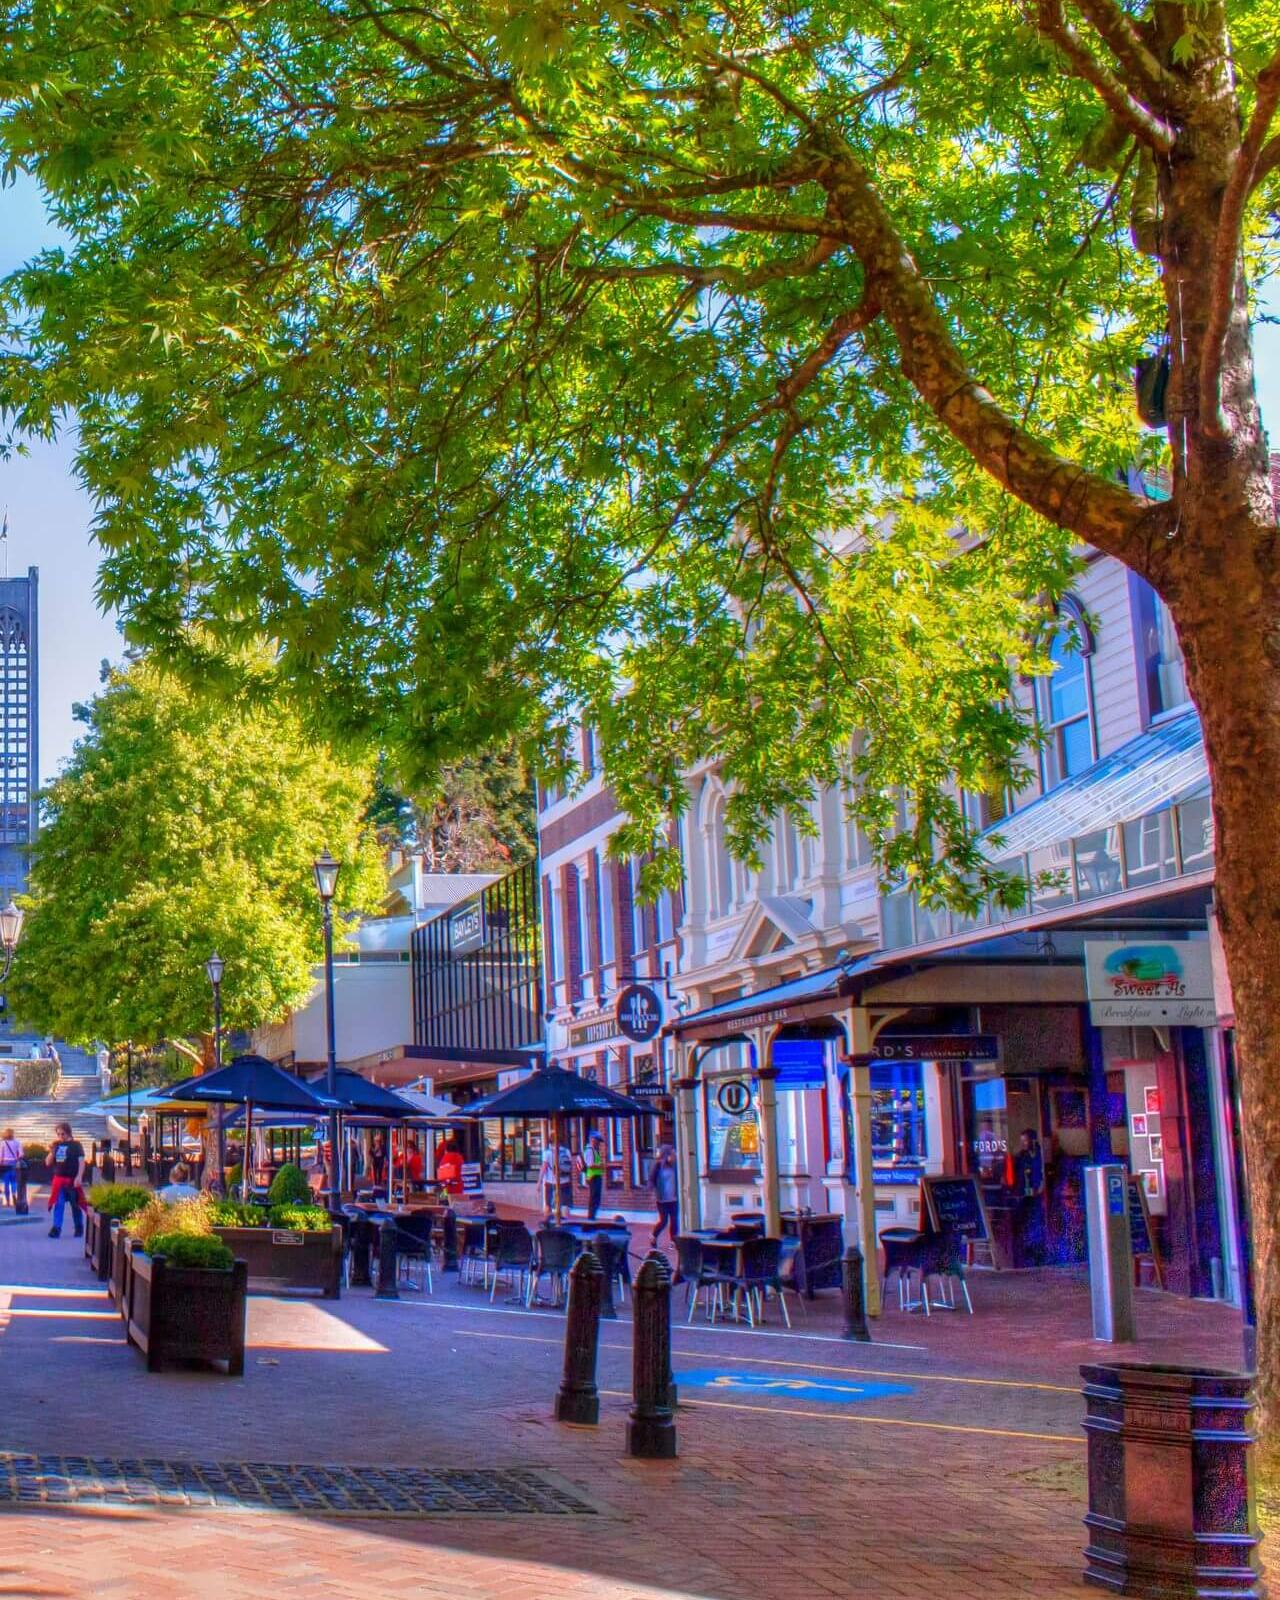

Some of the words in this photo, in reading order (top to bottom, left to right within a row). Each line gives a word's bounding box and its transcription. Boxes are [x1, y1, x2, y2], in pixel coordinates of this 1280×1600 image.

[1113, 981, 1161, 997] Sweet
[871, 1045, 914, 1057] RD'S
[973, 1140, 1008, 1152] FORD'S
